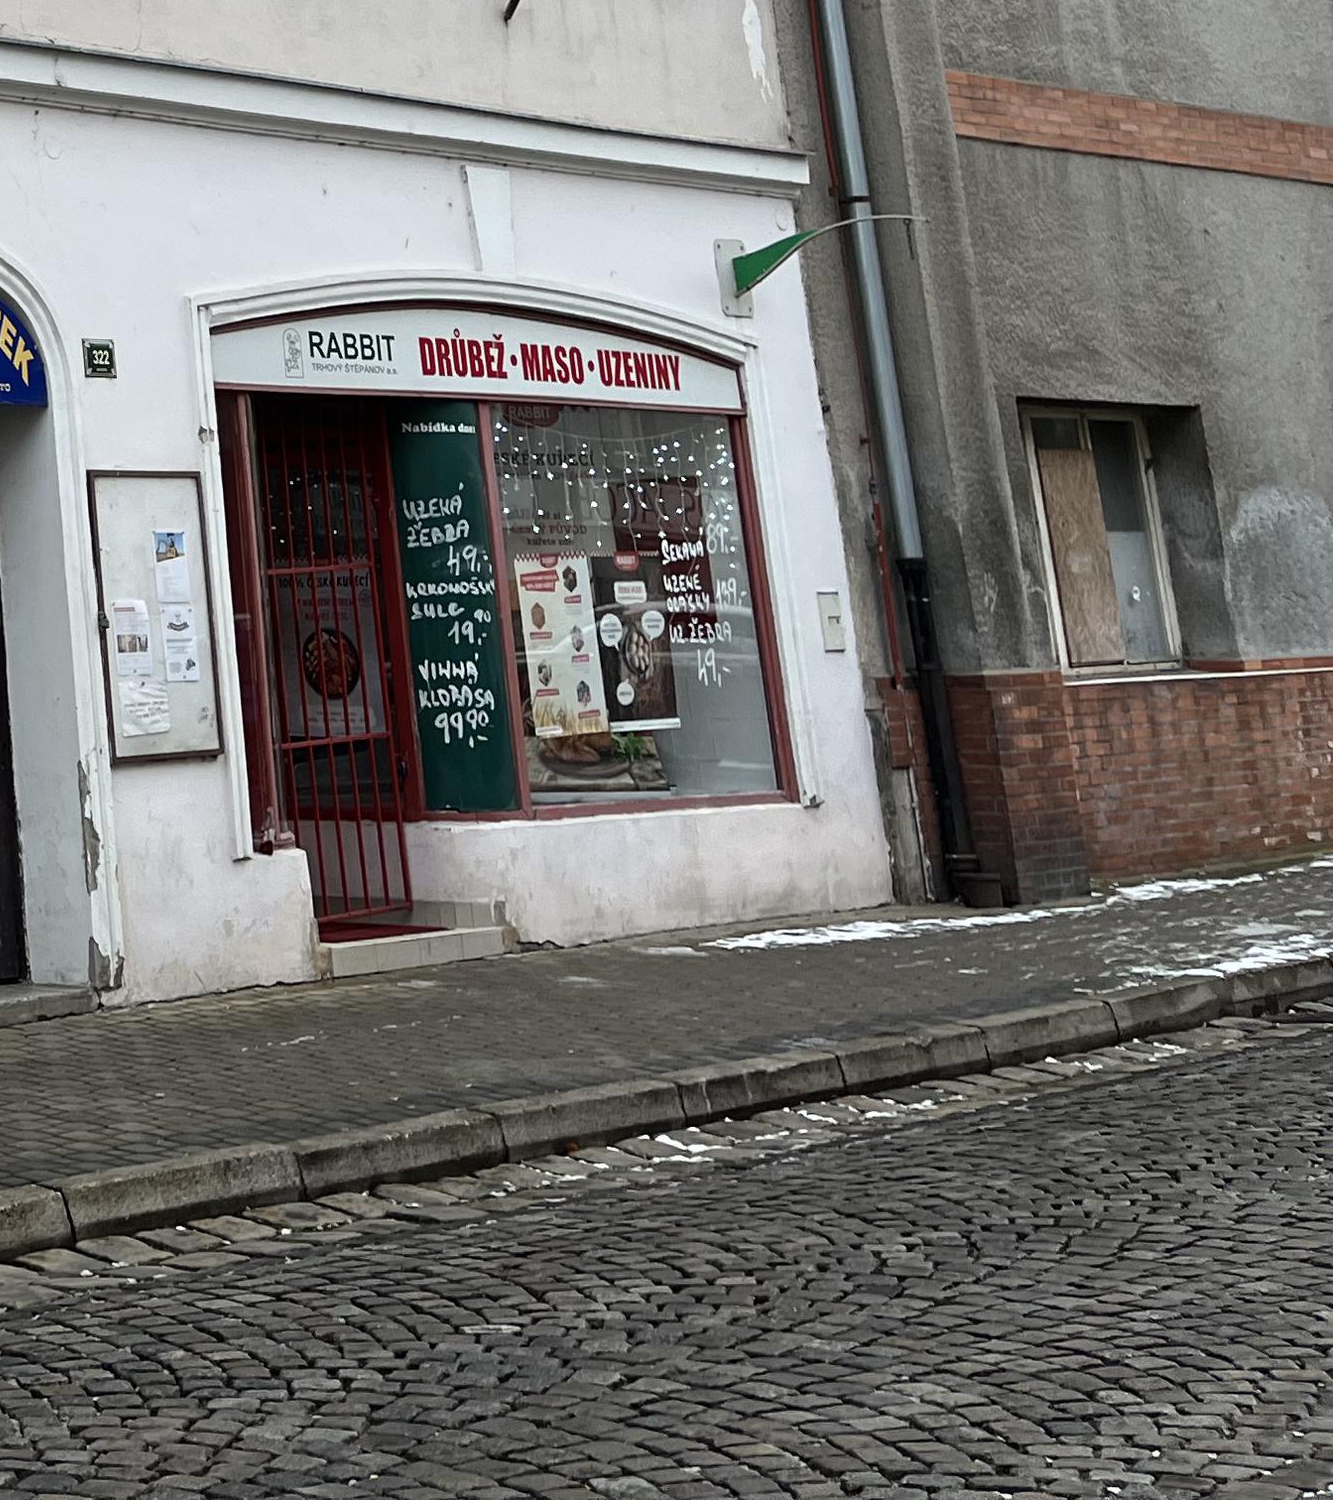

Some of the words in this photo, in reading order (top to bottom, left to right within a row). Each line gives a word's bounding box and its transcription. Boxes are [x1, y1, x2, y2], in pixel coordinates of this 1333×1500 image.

[308, 331, 395, 361] RABBIT
[92, 350, 110, 365] 322
[418, 328, 508, 379] DRŮBEŽ
[520, 343, 585, 385] MASO
[597, 349, 681, 391] UZENINY
[508, 405, 551, 419] RABBIT
[401, 422, 456, 433] Nabídka
